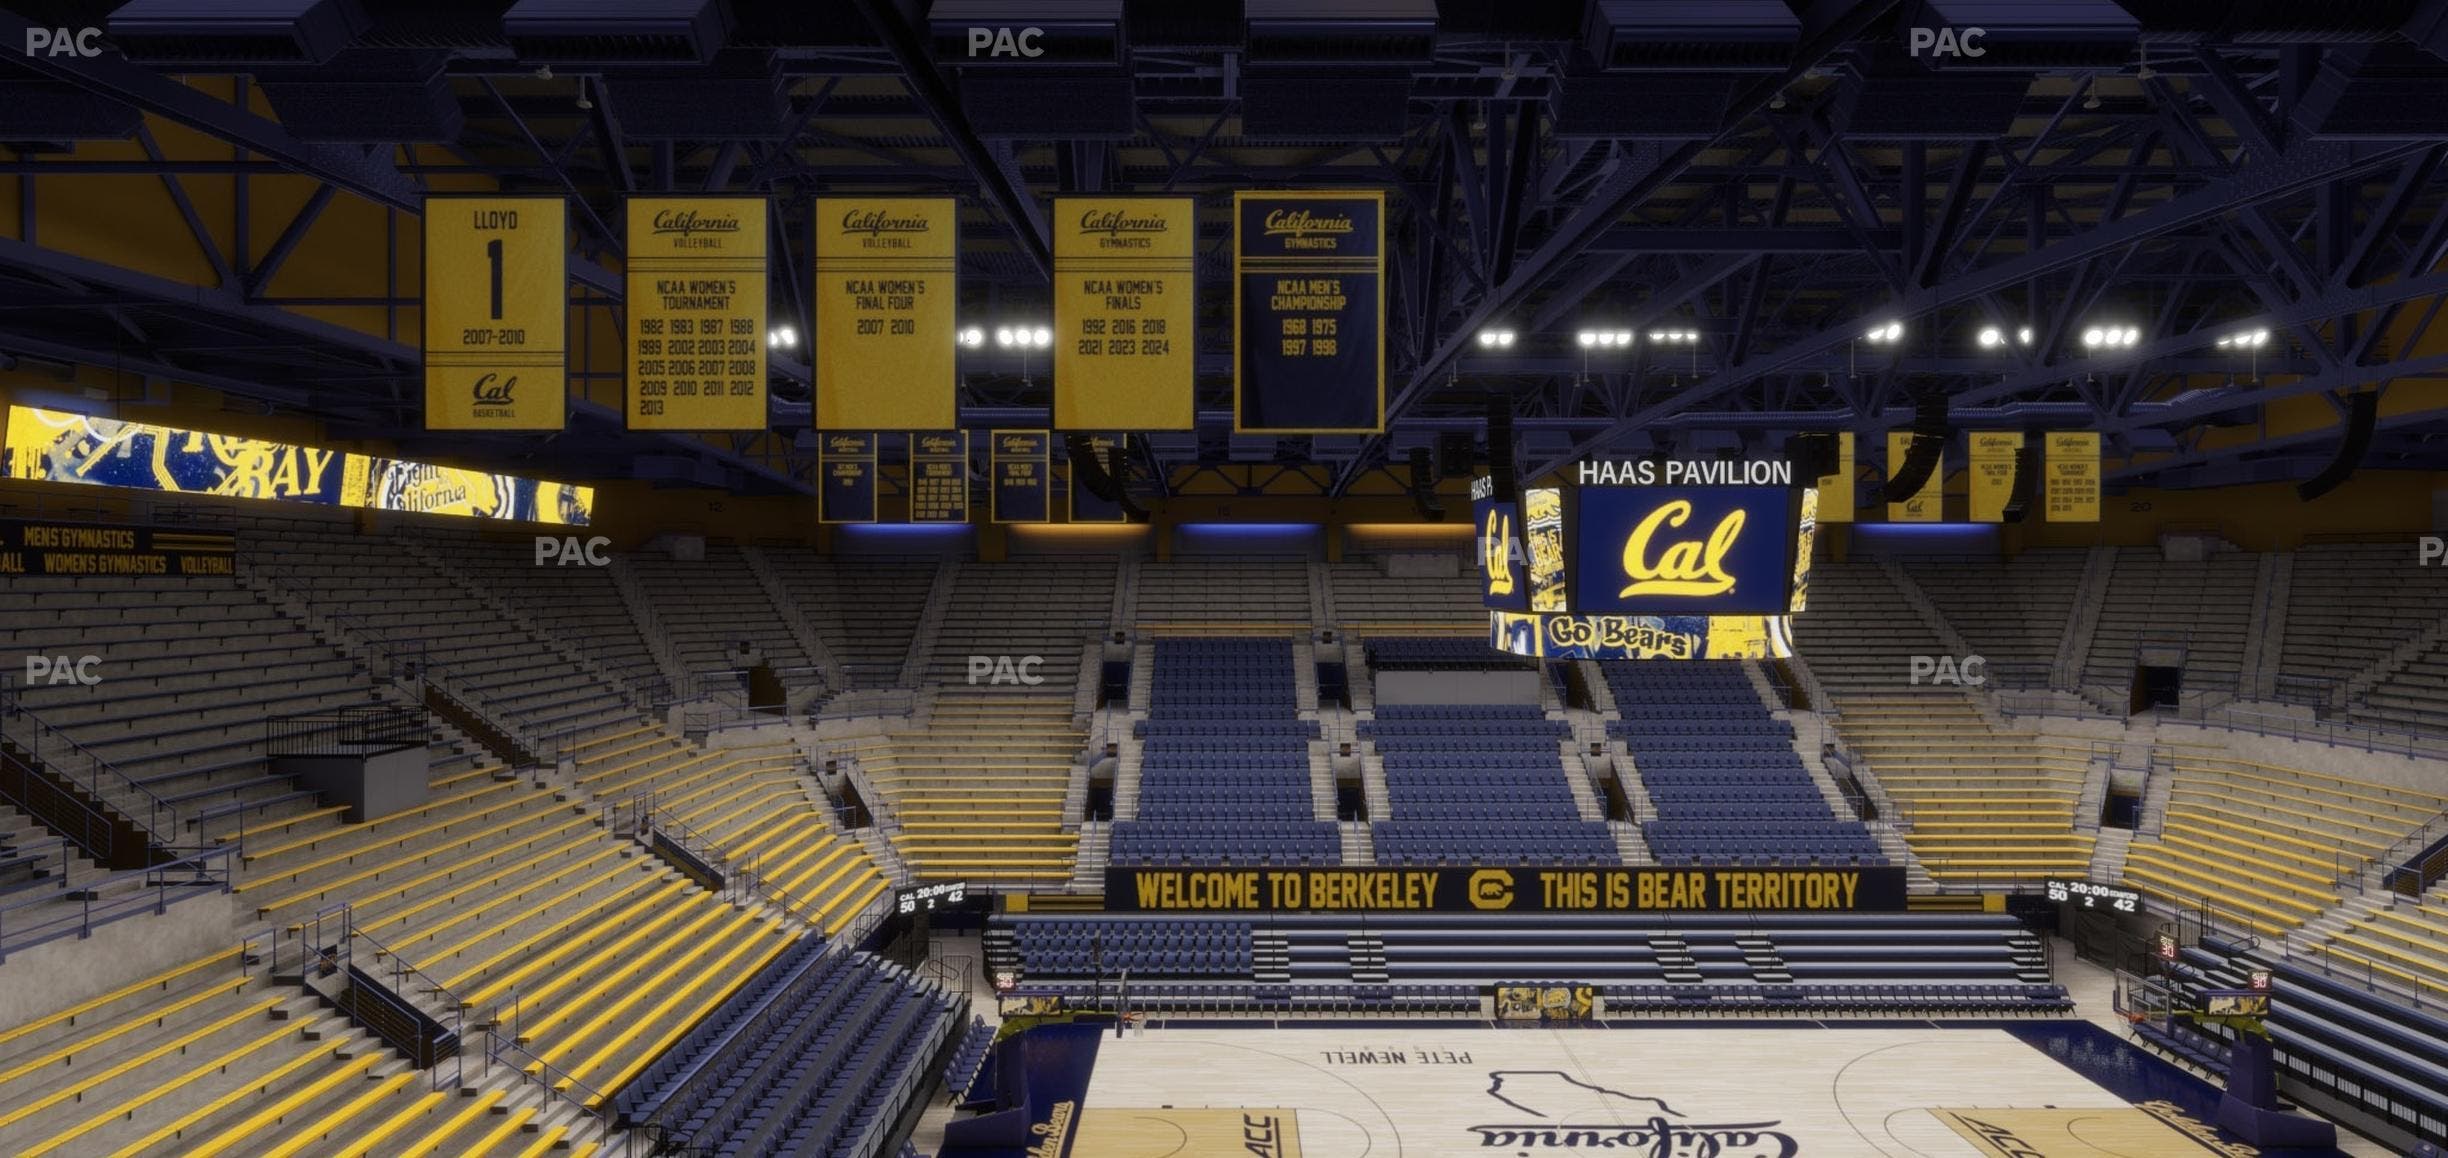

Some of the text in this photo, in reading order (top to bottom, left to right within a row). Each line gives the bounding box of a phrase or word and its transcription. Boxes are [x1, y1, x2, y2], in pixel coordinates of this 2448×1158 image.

[474, 211, 517, 229] LLOYD
[652, 210, 740, 236] California
[841, 209, 929, 237] California
[1080, 209, 1167, 236] California
[1264, 208, 1354, 237] California
[673, 238, 722, 248] VOLLEYBALL
[862, 238, 912, 248] VOLLEYBALL
[1100, 238, 1151, 248] GYMNASTICS
[1285, 238, 1336, 249] GYMNASTICS
[487, 239, 503, 320] 1
[656, 280, 735, 294] NCAA WOMEN'S
[846, 280, 925, 294] NCAA WOMEN'S
[1084, 280, 1163, 295] NCAA WOMEN'S
[1277, 280, 1340, 295] NCAA MEN'S
[663, 296, 730, 310] TOURNAMENT
[856, 296, 914, 310] FINAL FOUR
[1106, 296, 1141, 310] FINALS
[1271, 296, 1347, 311] CHAMPIONSHIP
[857, 319, 914, 334] 2007 2010
[1082, 319, 1166, 334] 1992 2016 2018
[1282, 319, 1337, 335] 1968 1975
[463, 329, 525, 345] 2007-2010
[668, 340, 694, 355] 2002
[699, 340, 725, 355] 2003
[728, 340, 756, 355] 2004
[1078, 340, 1170, 355] 2021 2023 2024
[1282, 340, 1337, 356] 1997 1998
[638, 361, 756, 376] 2005 2006 2007 2008
[472, 373, 518, 406] Cal
[640, 381, 753, 396] 2009 2010 2011 2012
[472, 409, 516, 418] BASKETBALL
[640, 401, 663, 416] 2013
[1579, 460, 1792, 484] HAAS PAVILION
[62, 528, 134, 548] GYMNASTICS
[1619, 500, 1746, 599] Cal
[99, 555, 166, 574] GYMNASTICS
[181, 556, 233, 574] VOLLEYBALL
[1552, 617, 1687, 656] Go Bears
[899, 893, 915, 901] CAL
[917, 884, 945, 899] 20:00
[1136, 872, 1439, 909] WELCOME TO BERKELEY
[1540, 872, 1859, 909] THIS IS BEAR TERRITORY
[2048, 881, 2068, 889] CAL
[2070, 882, 2109, 896] 20:00
[900, 890, 964, 913] 50 2 42
[2048, 888, 2135, 912] 50 2 42
[2161, 944, 2174, 957] 30
[1320, 1051, 1473, 1064] PETE NEWELL
[1243, 1113, 1275, 1158] ACC
[1467, 1116, 1800, 1158] California
